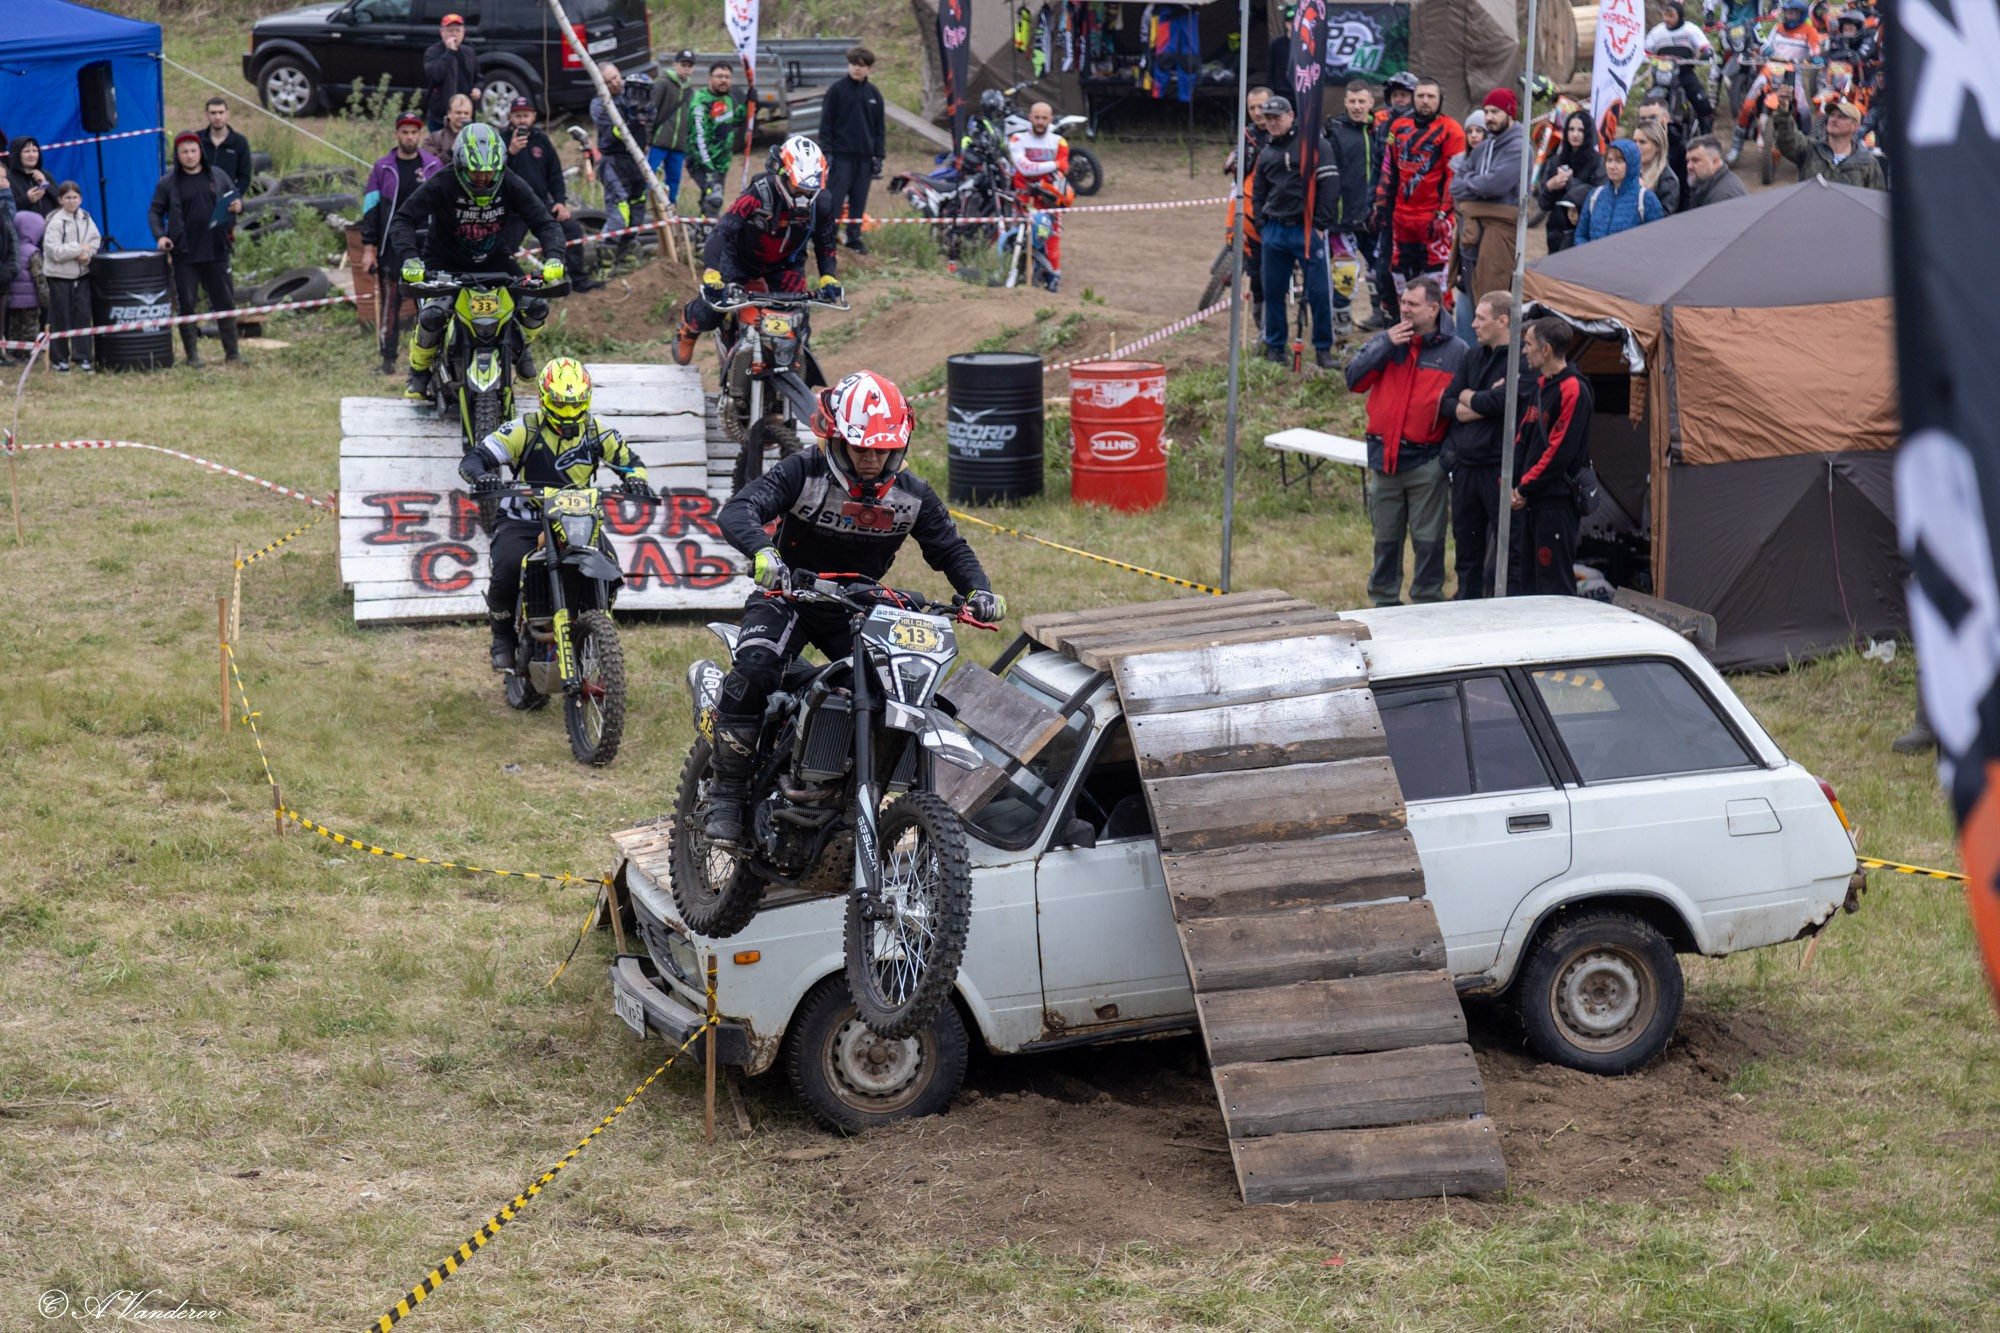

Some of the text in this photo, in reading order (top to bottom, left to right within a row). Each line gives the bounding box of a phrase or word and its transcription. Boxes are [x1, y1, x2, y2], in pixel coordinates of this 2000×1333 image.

[477, 302, 492, 311] 33
[774, 321, 781, 331] 2
[864, 432, 898, 447] GTX
[1091, 439, 1137, 450] SINTEC
[567, 497, 581, 507] 19
[900, 618, 915, 627] HILL
[907, 627, 926, 644] 13
